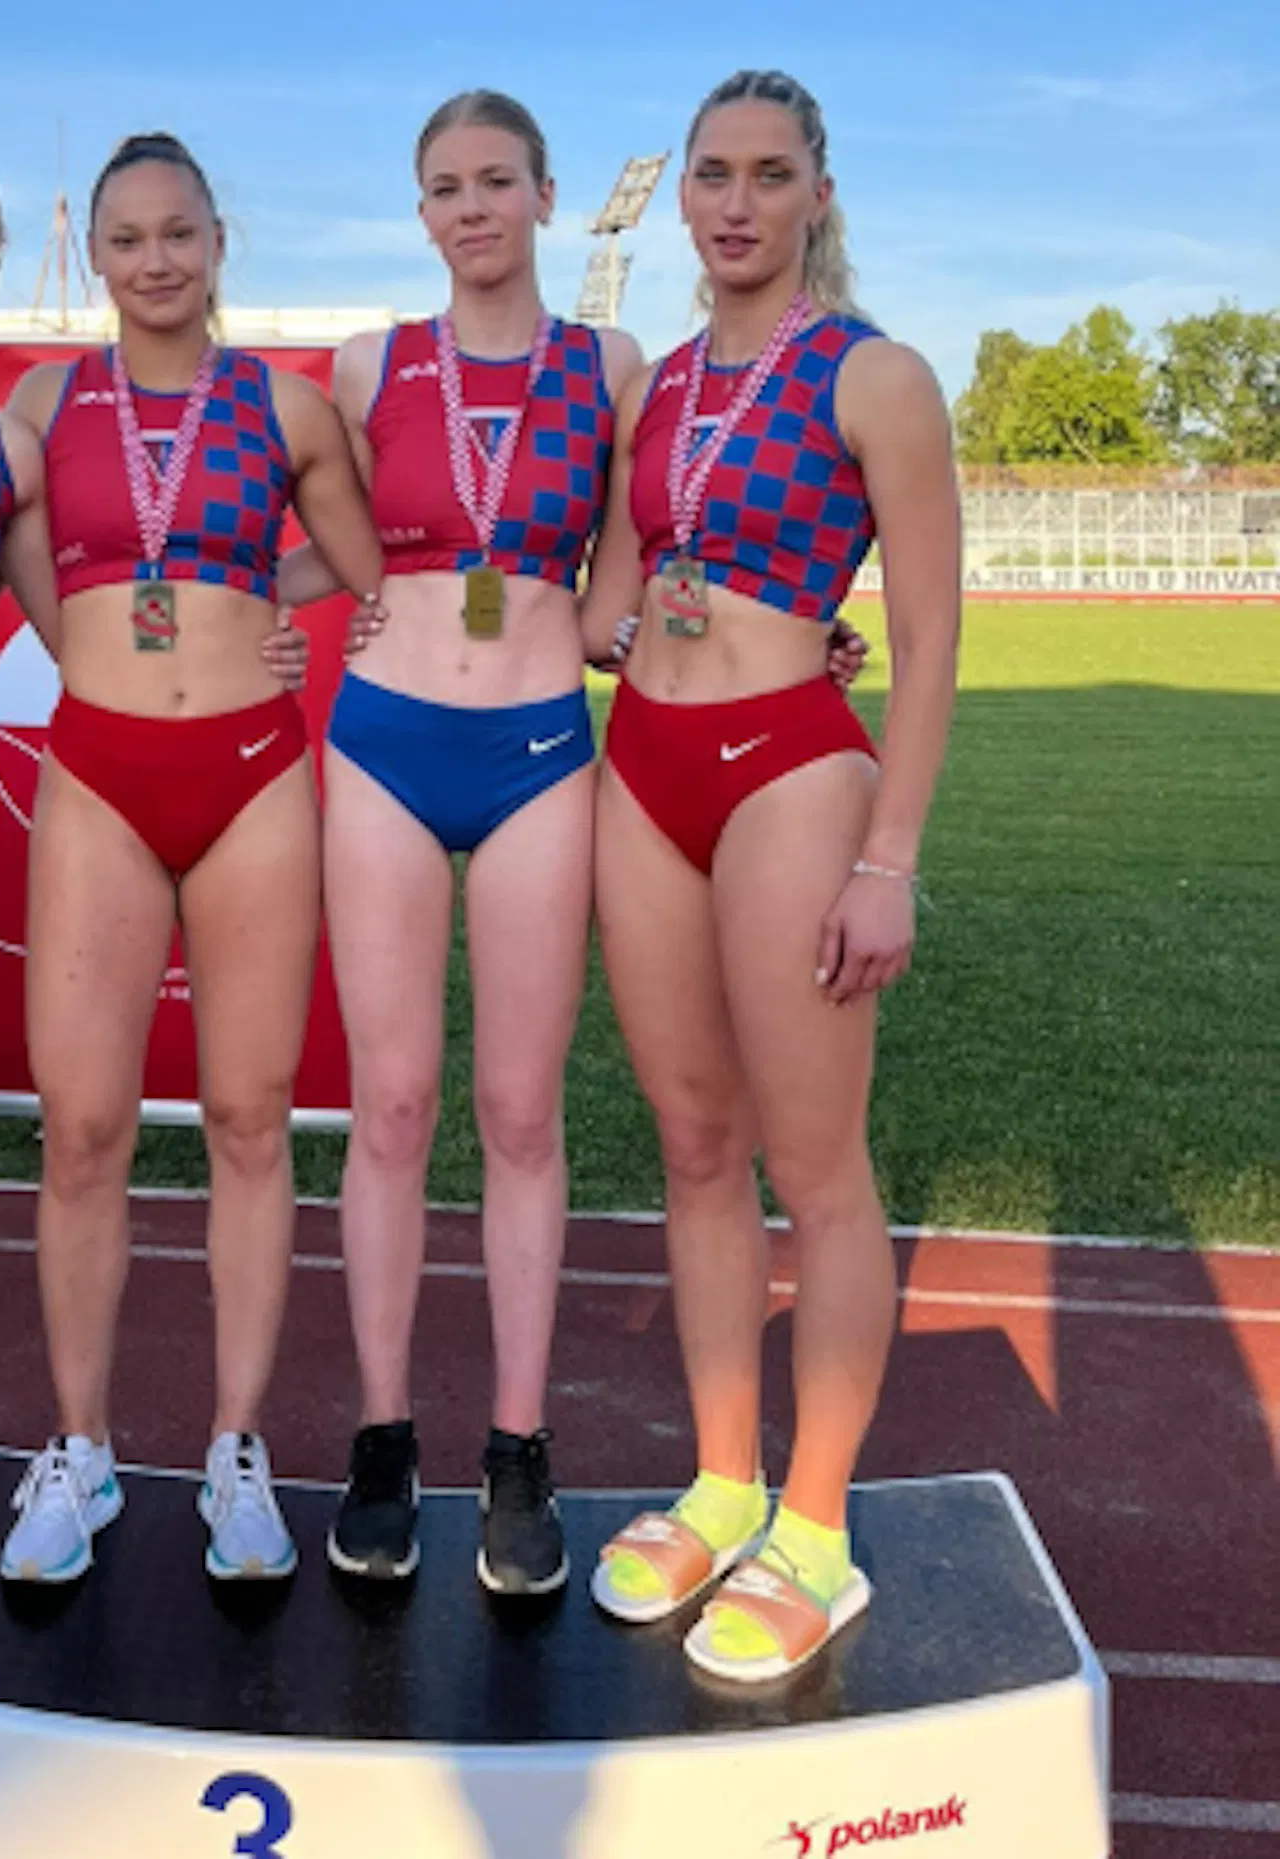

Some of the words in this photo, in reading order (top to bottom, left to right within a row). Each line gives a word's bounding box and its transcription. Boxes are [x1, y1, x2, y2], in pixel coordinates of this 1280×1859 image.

[1083, 569, 1149, 589] KLUB
[198, 1770, 294, 1859] 3
[826, 1793, 968, 1859] polanik
